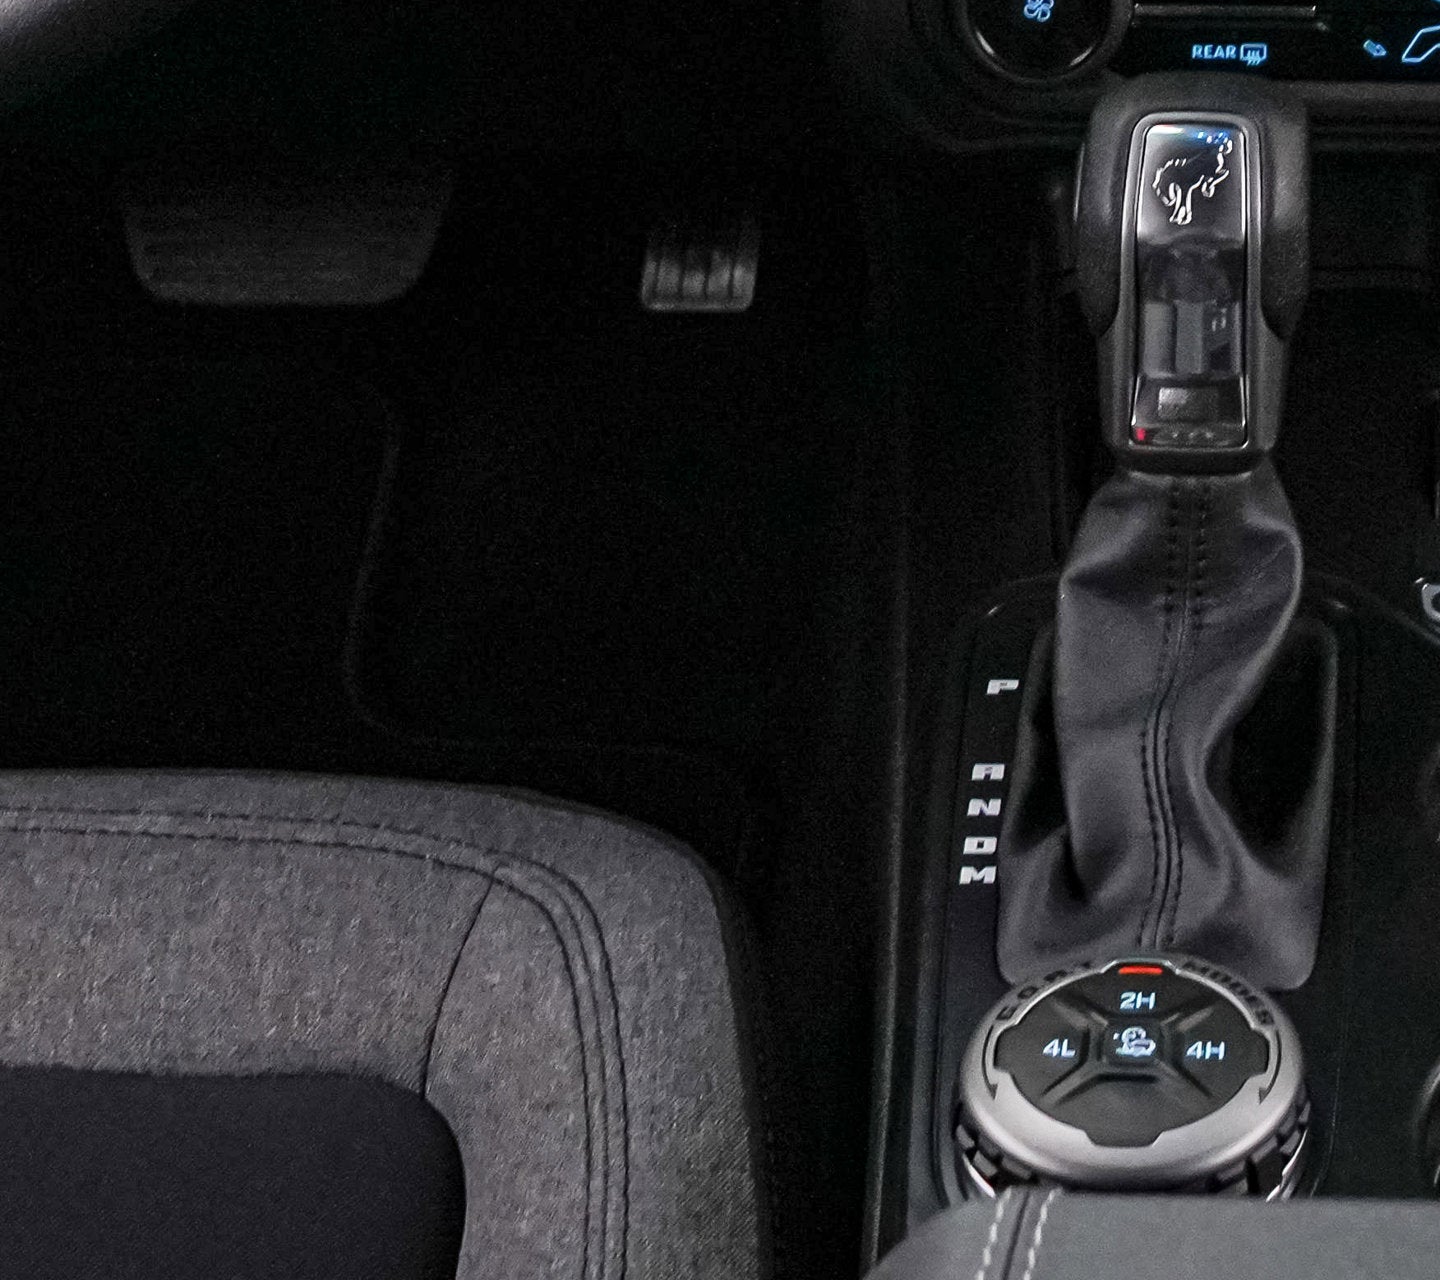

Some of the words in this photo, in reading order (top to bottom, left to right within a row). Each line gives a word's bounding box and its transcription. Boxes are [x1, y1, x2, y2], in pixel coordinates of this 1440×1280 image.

[1192, 45, 1237, 60] REAR
[986, 679, 1019, 695] P
[967, 798, 1002, 816] N
[963, 836, 997, 855] D
[959, 866, 997, 885] M
[1120, 991, 1157, 1010] 2H
[1043, 1038, 1076, 1058] 4L
[1186, 1041, 1225, 1060] 4H
